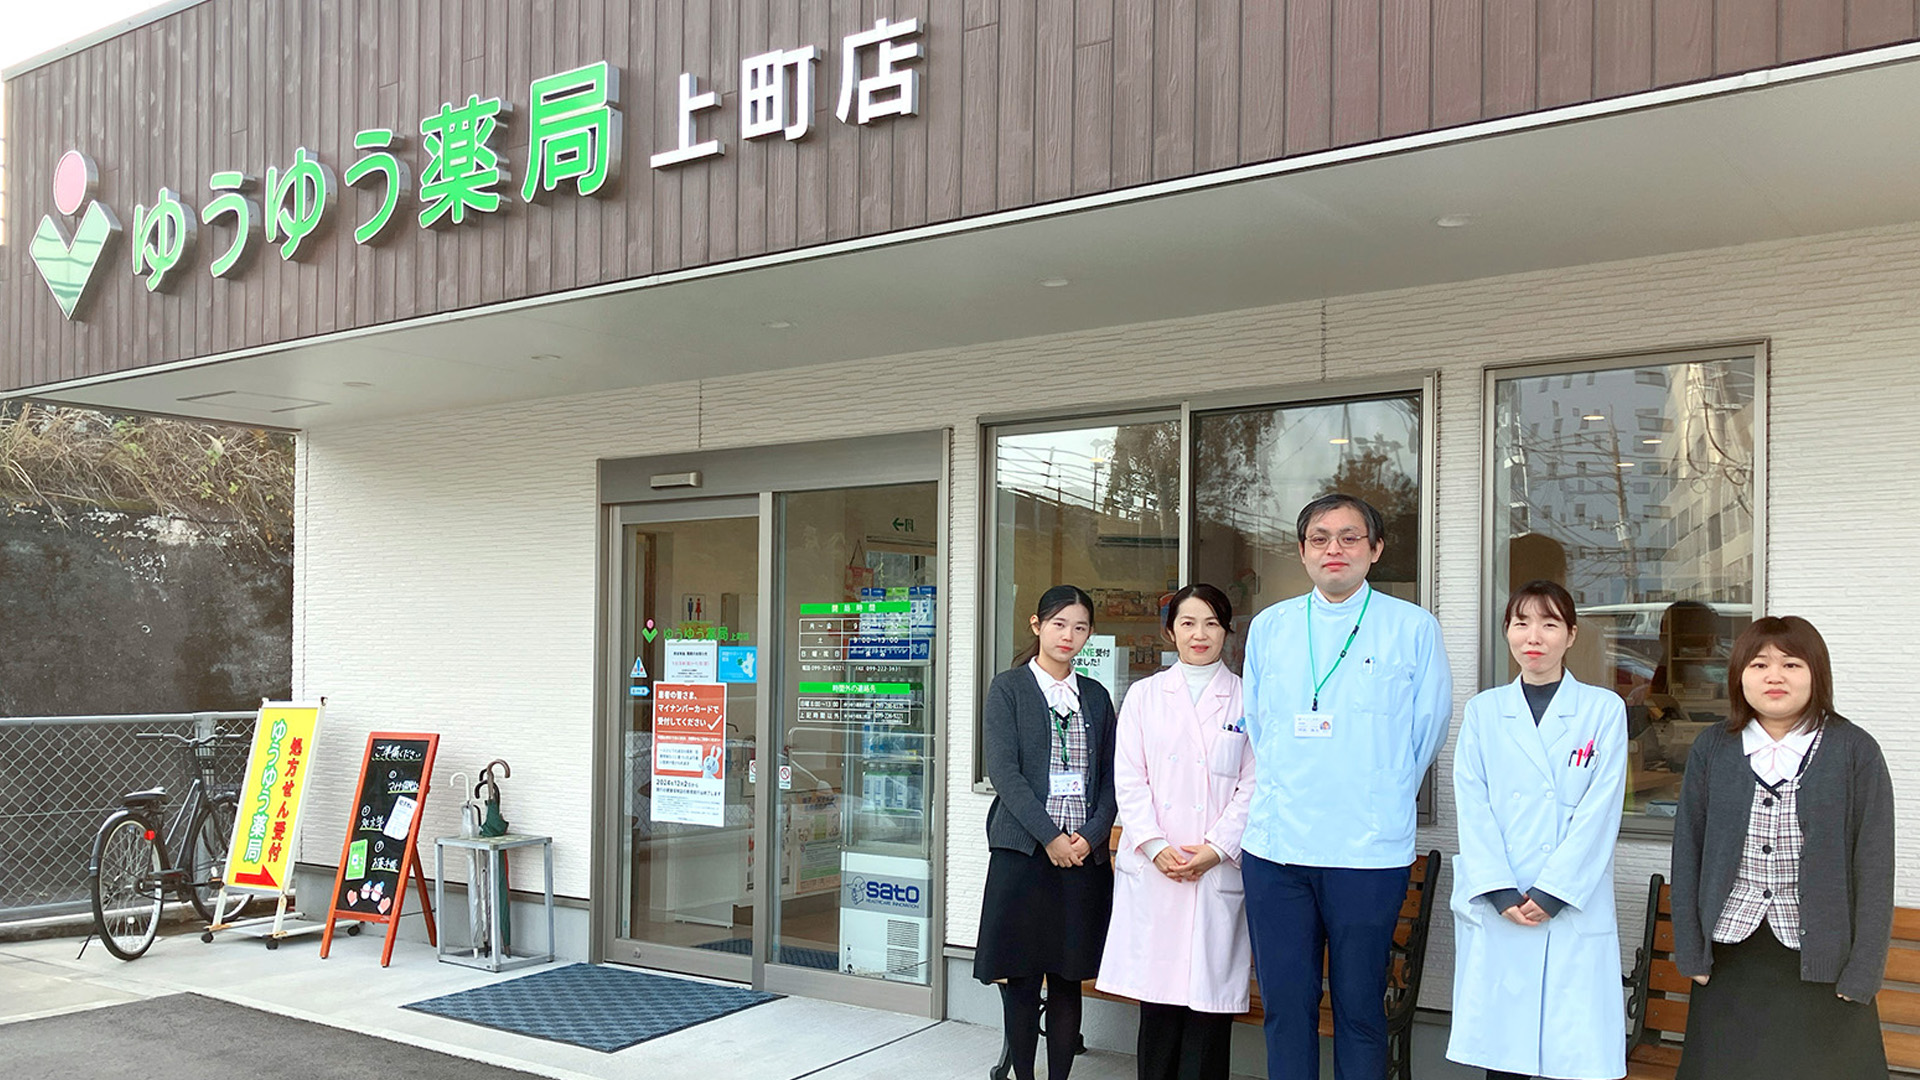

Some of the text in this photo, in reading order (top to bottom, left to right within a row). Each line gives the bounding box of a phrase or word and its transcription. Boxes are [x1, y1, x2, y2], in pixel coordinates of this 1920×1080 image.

[132, 17, 926, 292] ゆうゆう薬局 上町店
[664, 626, 728, 642] ゆうゆう薬局
[658, 704, 720, 714] マイナンバーカードで
[657, 716, 707, 727] 受付してください
[243, 719, 288, 864] ゆうゆう薬局
[267, 737, 303, 863] 処方せん受付
[866, 881, 920, 904] sato
